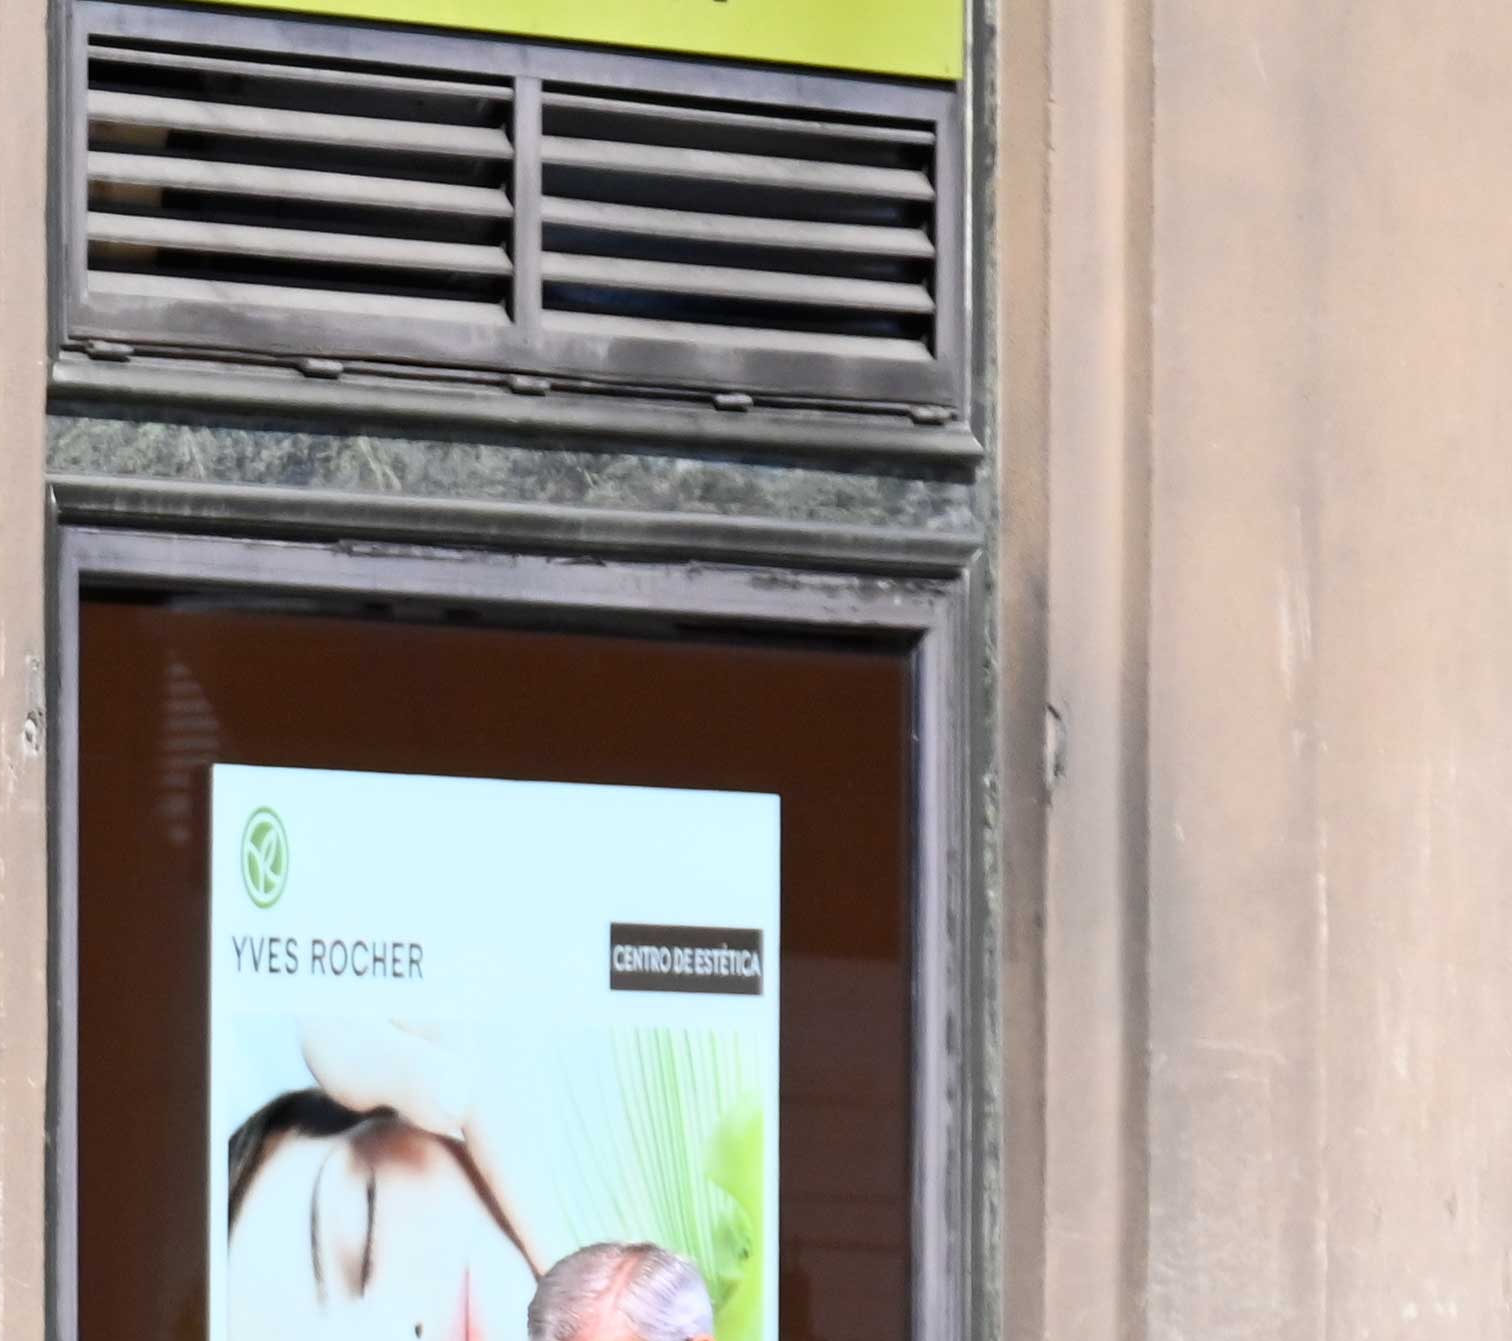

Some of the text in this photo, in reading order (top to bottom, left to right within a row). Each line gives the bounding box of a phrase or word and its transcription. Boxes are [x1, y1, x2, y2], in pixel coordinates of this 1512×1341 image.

[233, 937, 423, 978] YVES ROCHER
[613, 941, 761, 977] CENTRO DE ESTÉTICA
